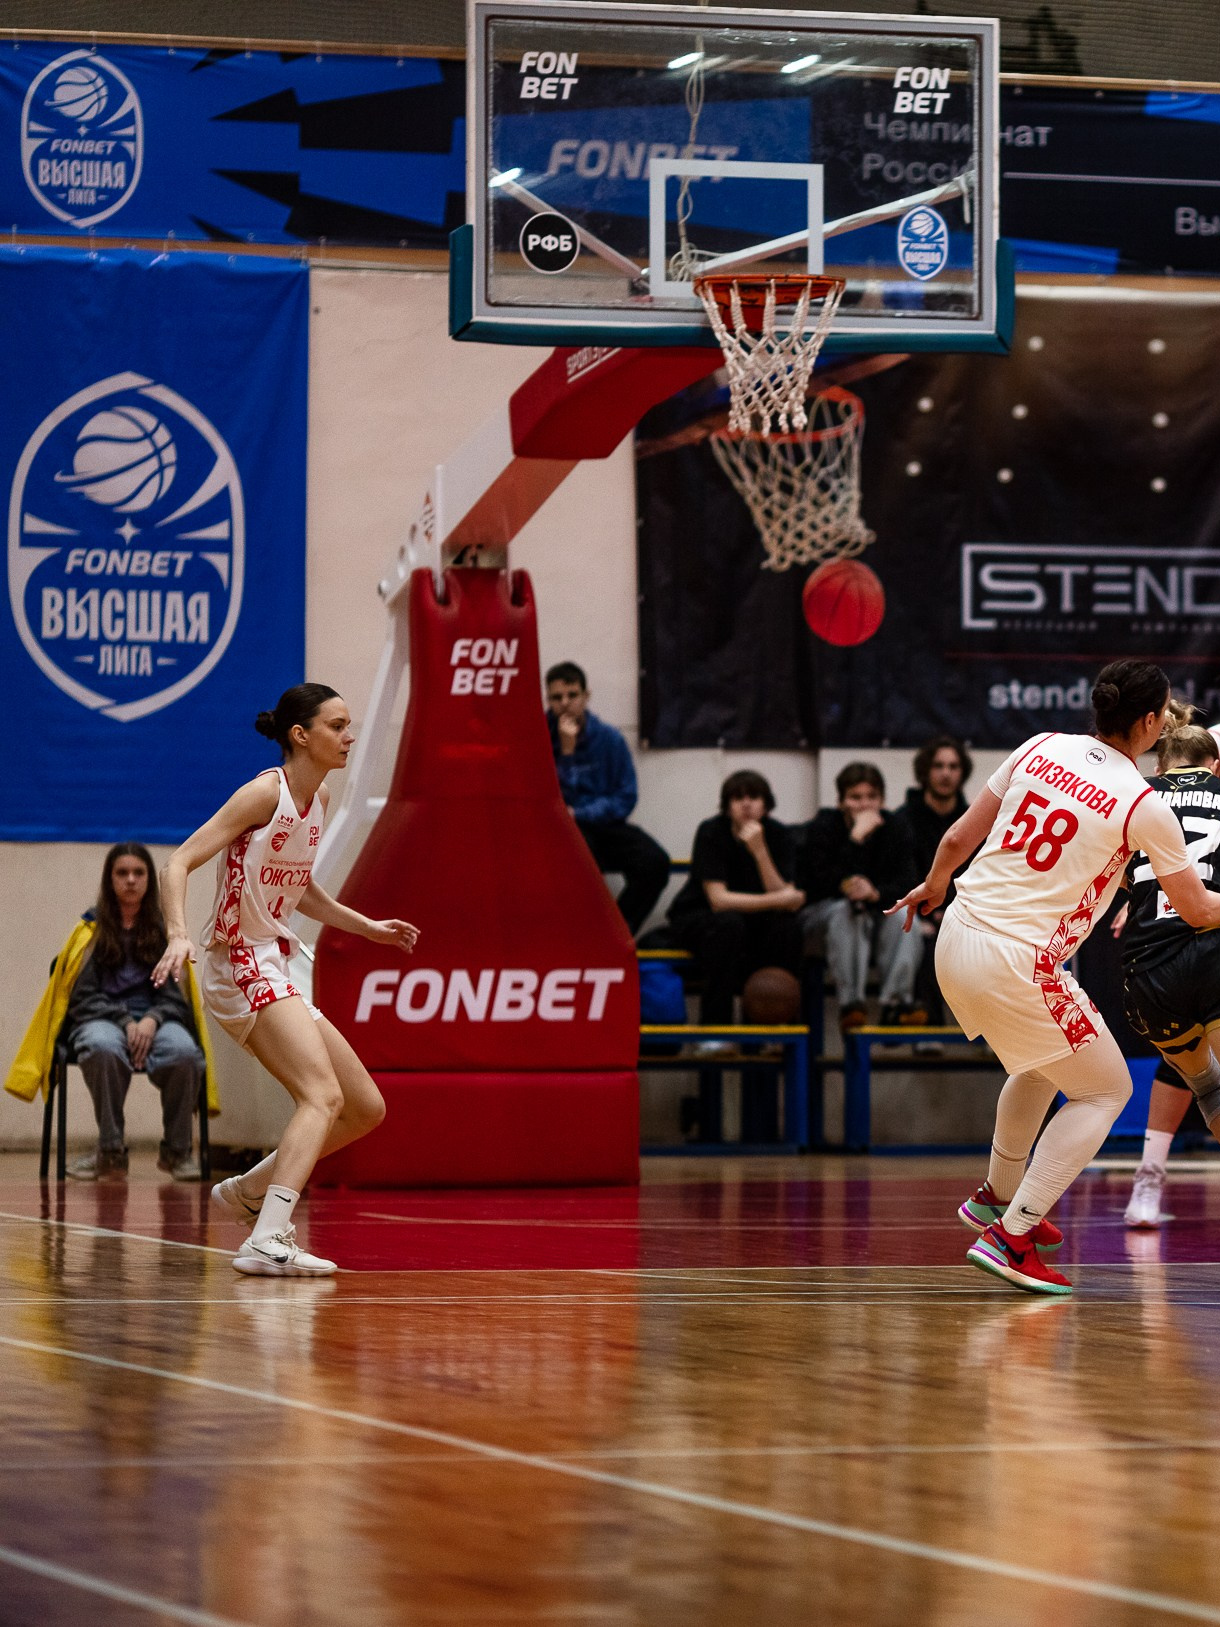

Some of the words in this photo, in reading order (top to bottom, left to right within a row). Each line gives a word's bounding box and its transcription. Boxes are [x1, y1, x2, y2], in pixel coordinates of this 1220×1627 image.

[519, 51, 579, 75] FON
[520, 77, 579, 100] BET
[893, 67, 951, 90] FON
[893, 92, 951, 115] BET
[864, 112, 1053, 147] Чемпинат
[50, 139, 117, 155] FONBET
[38, 159, 126, 190] ВЫСШАЯ
[527, 234, 573, 252] РФБ
[65, 549, 193, 577] FONBET
[41, 587, 210, 644] ВЫСШАЯ
[98, 645, 153, 676] ЛИГА
[450, 638, 519, 666] FON
[450, 667, 519, 696] BET
[1025, 755, 1118, 820] СИЗЯКОВА
[1001, 790, 1079, 872] 58
[354, 968, 626, 1024] FONBET
